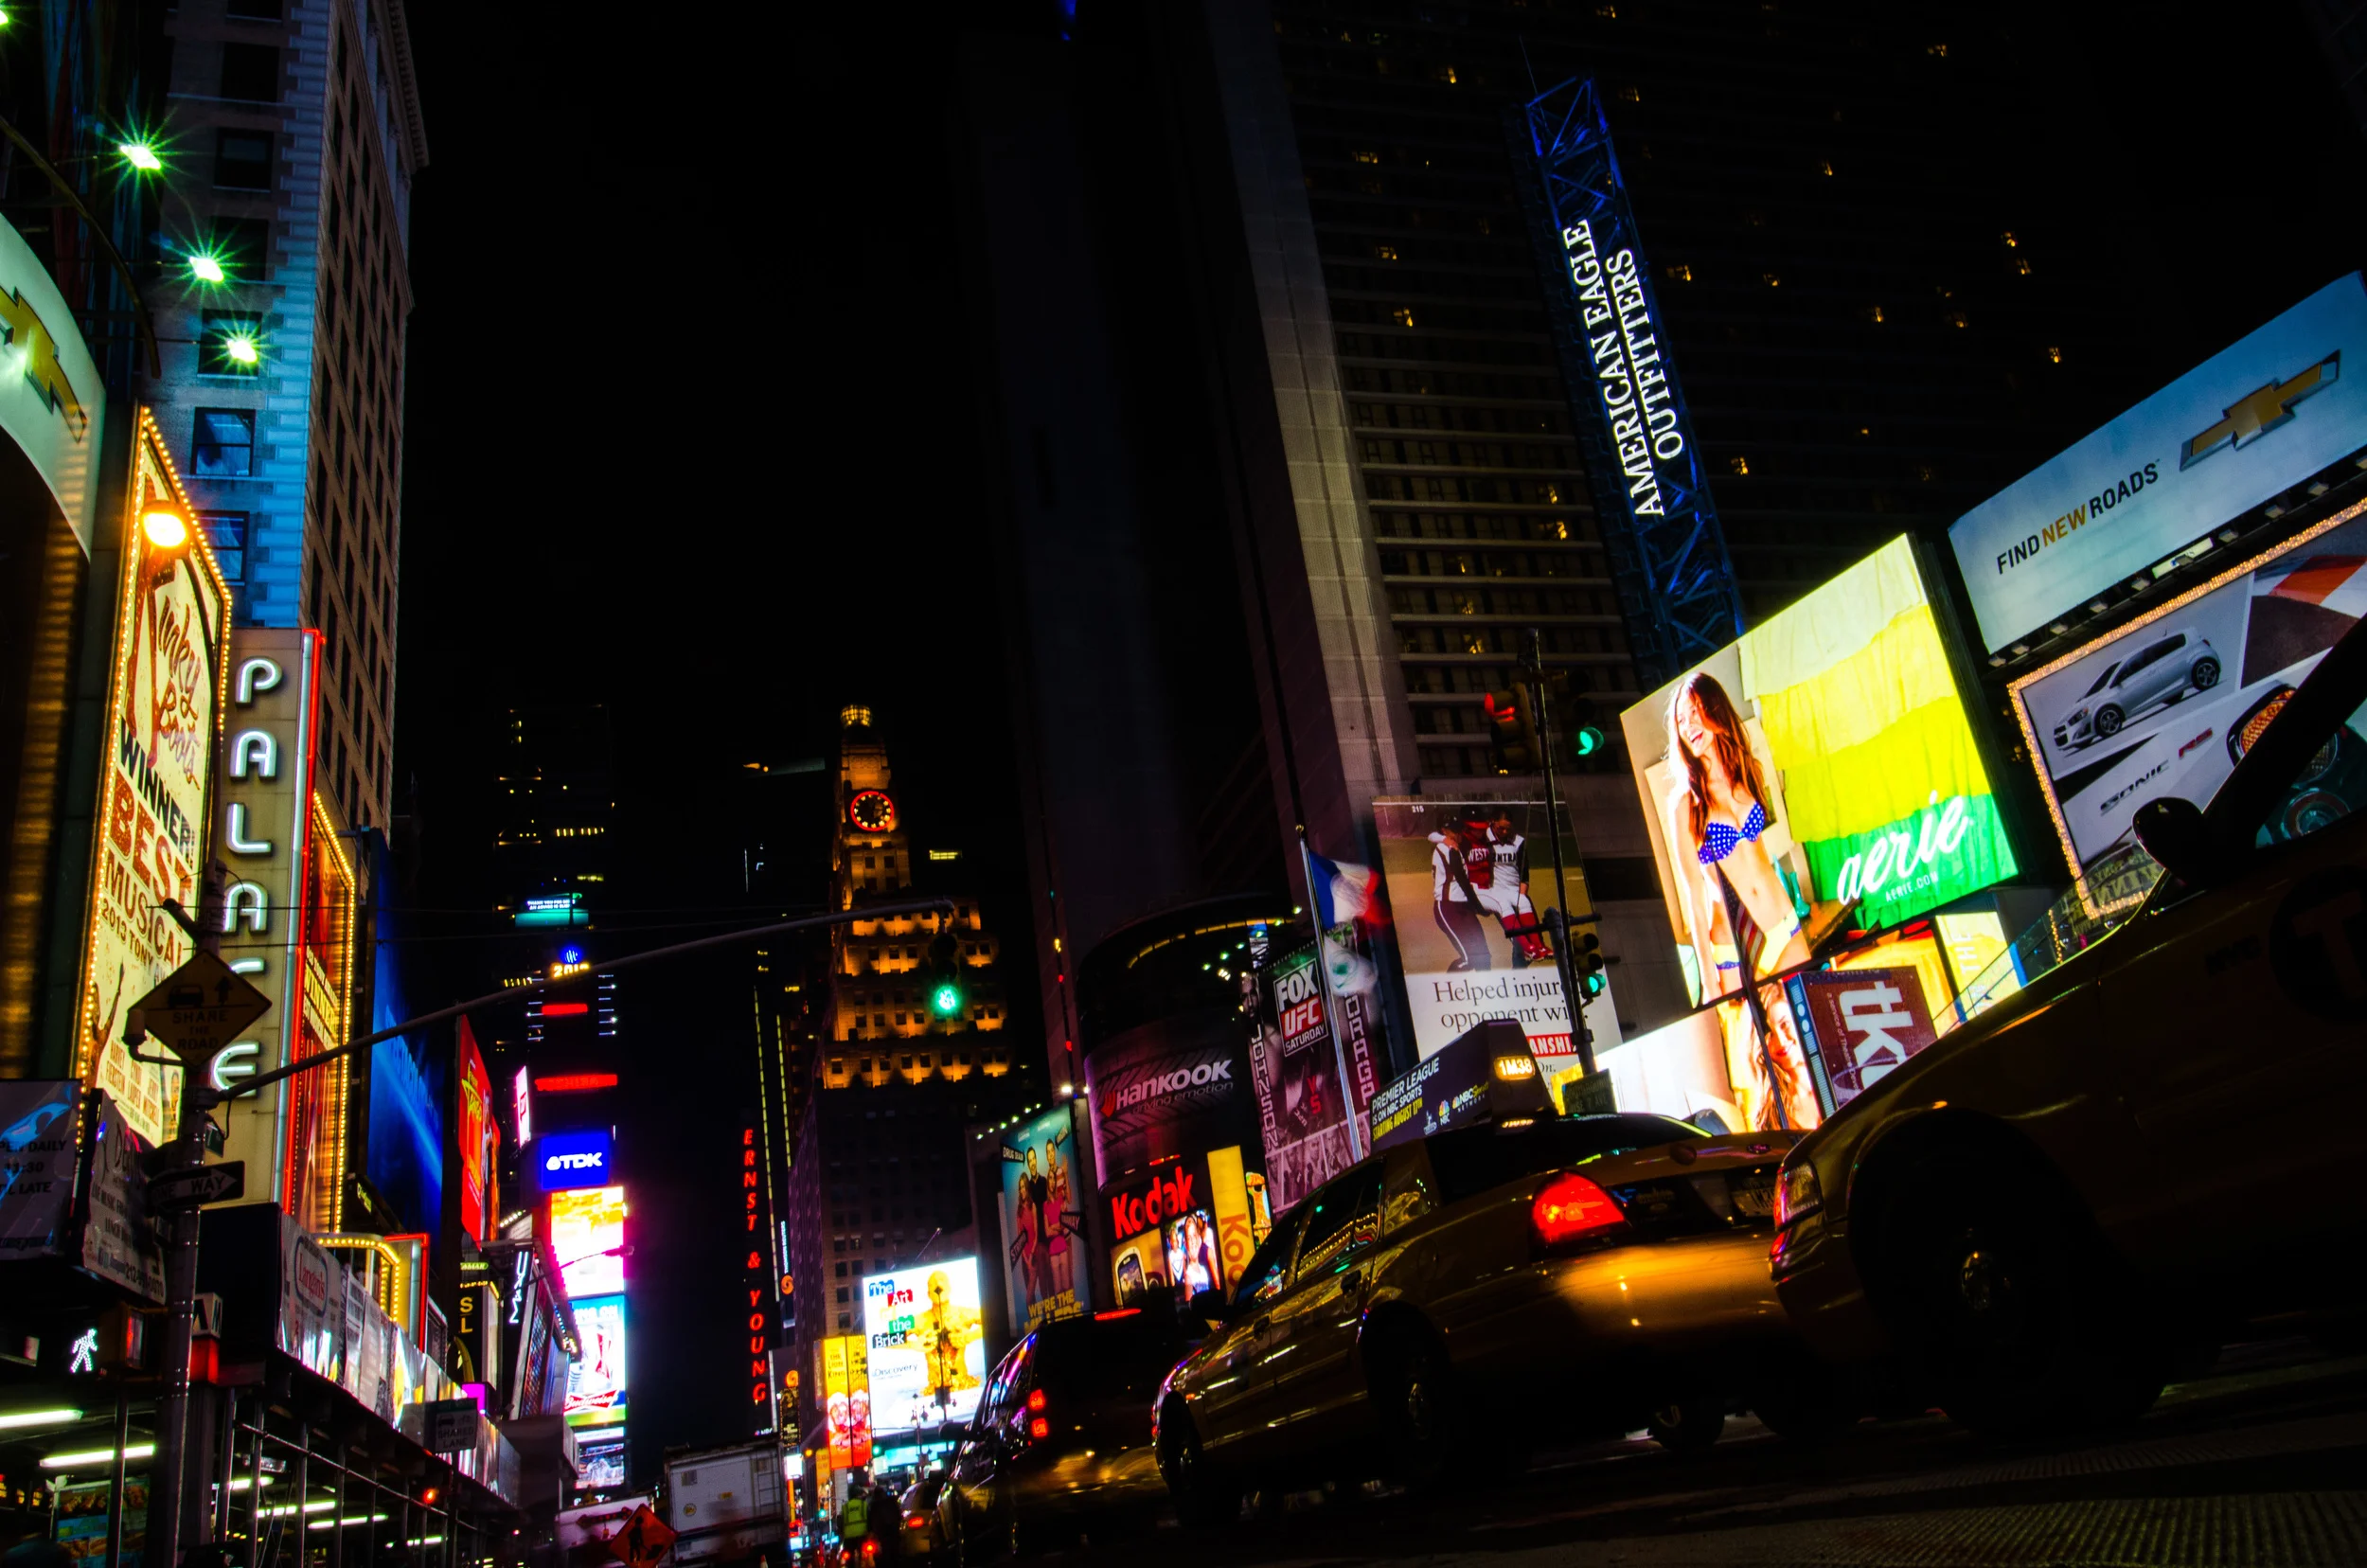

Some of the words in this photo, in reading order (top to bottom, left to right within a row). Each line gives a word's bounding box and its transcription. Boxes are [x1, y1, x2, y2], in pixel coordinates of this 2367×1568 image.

[1563, 219, 1612, 330] EAGLE
[1606, 248, 1684, 461] OUTFITTERS
[1591, 331, 1664, 517] AMERICAN
[1997, 535, 2040, 575] FIND
[2042, 504, 2087, 547] NEW
[2090, 462, 2160, 519] ROADS
[109, 767, 193, 907] BEST
[1837, 790, 1969, 906] aerie
[212, 657, 282, 1098] PALAE
[1885, 870, 1940, 902] AERIE.COM
[101, 897, 128, 943] 2013
[104, 848, 184, 971] MUSICAL
[1275, 964, 1319, 1012] FOX
[1434, 976, 1509, 1007] Helped
[1513, 975, 1564, 1002] injur
[172, 1011, 228, 1024] SHARE
[188, 1025, 210, 1036] THE
[1284, 998, 1321, 1039] UFC
[177, 1037, 220, 1050] ROAD
[1285, 1024, 1326, 1053] SATURDAY
[1498, 1058, 1533, 1076] 1M38
[1174, 1080, 1234, 1101] emotion
[1251, 1023, 1280, 1152] JOHNSON
[1372, 1079, 1405, 1114] PREMIER
[1406, 1057, 1439, 1091] LEAGUE
[1373, 1114, 1379, 1127] IS
[1378, 1107, 1387, 1123] ON
[1387, 1099, 1399, 1117] NBC
[1399, 1084, 1423, 1109] SPORTS
[1373, 1116, 1394, 1142] STARTING
[28, 1140, 67, 1152] DAILY
[559, 1151, 603, 1170] TDK
[19, 1181, 52, 1195] LATE
[191, 1176, 226, 1196] WAY
[743, 1128, 757, 1232] ERNST
[1112, 1166, 1197, 1239] Kodak
[747, 1251, 761, 1270] &
[869, 1280, 893, 1296] The
[891, 1292, 910, 1306] Art
[1057, 1289, 1077, 1306] THE
[874, 1331, 906, 1349] Brick
[892, 1318, 912, 1332] the
[749, 1289, 767, 1401] YOUNG
